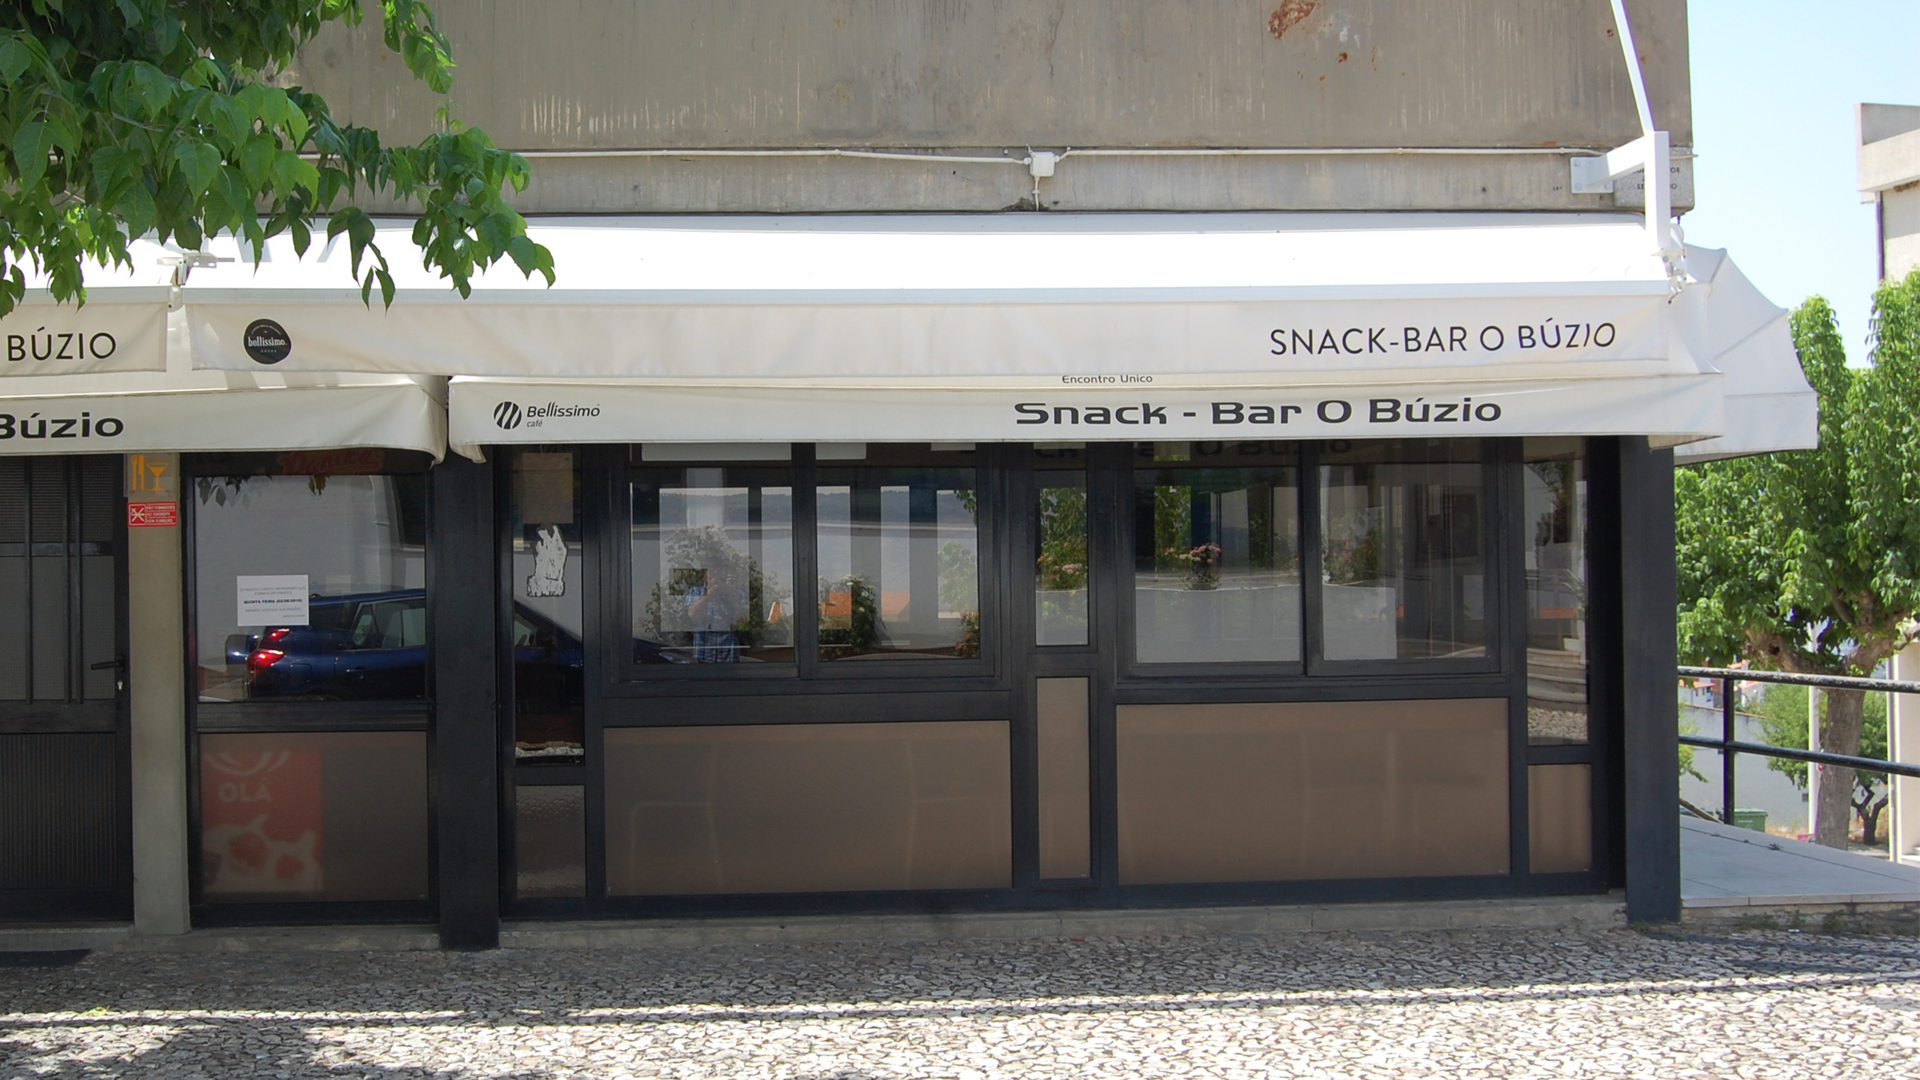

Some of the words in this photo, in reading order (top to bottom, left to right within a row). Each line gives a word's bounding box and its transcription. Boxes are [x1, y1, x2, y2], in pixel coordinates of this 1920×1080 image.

[7, 325, 117, 363] BÚZIO
[247, 336, 286, 347] bellissimo
[1270, 326, 1467, 356] SNACK-BAR
[1479, 325, 1505, 352] O
[1517, 317, 1616, 349] BÚZIO
[1061, 374, 1116, 384] Encontro
[526, 401, 601, 418] Bellissimo
[1014, 402, 1167, 425] Snack
[1211, 401, 1302, 425] Bar
[1316, 399, 1352, 424] O
[1369, 397, 1502, 423] Búzio
[0, 411, 125, 440] Búzio
[526, 419, 544, 428] café
